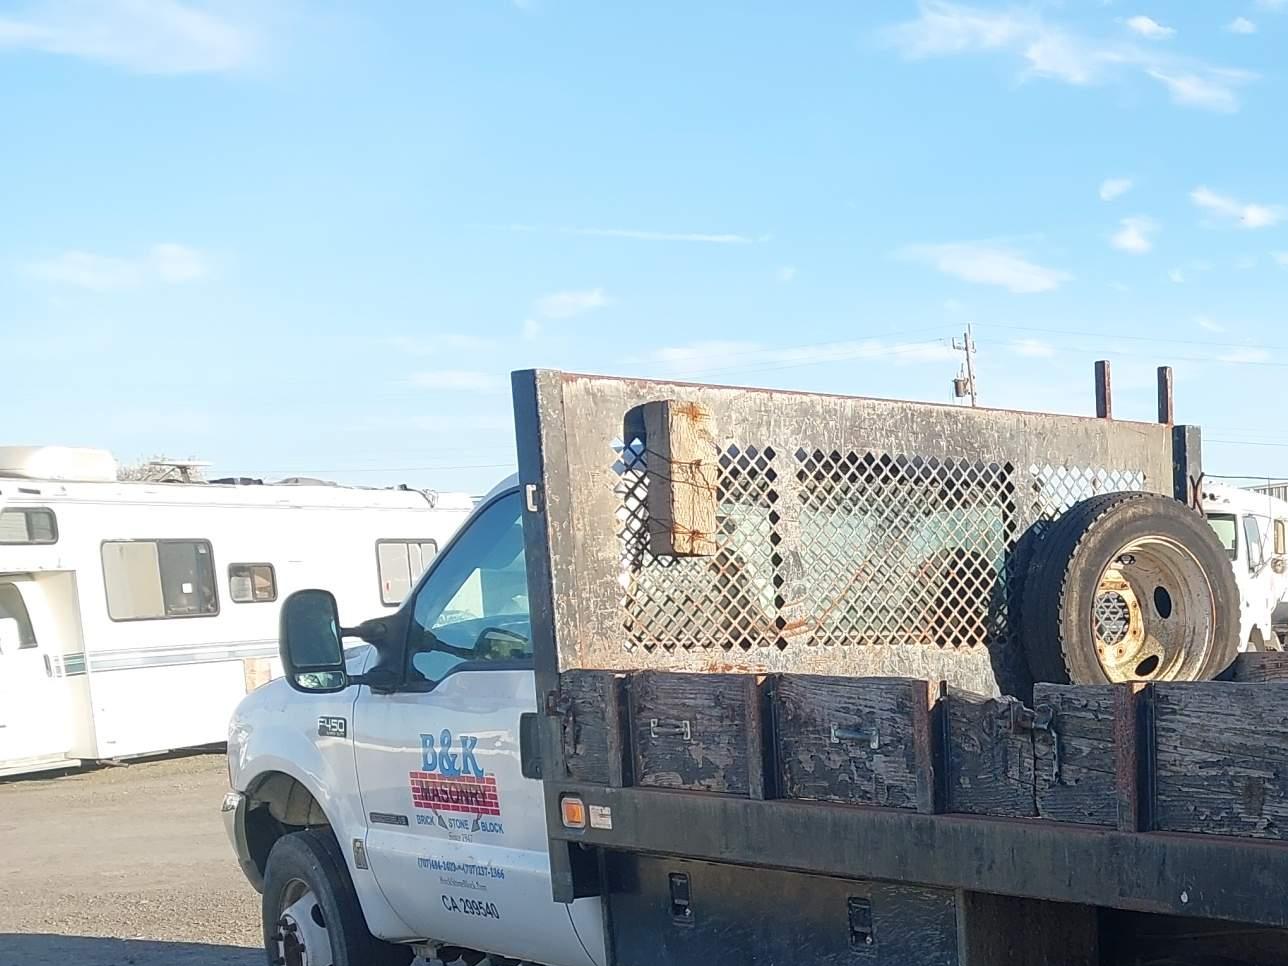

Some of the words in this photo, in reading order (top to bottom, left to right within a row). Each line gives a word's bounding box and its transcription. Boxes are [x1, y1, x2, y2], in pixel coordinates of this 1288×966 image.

[420, 728, 484, 777] B&K
[419, 780, 488, 806] MASONRY
[416, 814, 435, 826] BRICK
[448, 818, 469, 830] STONE
[480, 821, 504, 834] BLOCK
[441, 895, 461, 912] CA
[460, 898, 500, 920] 299540
